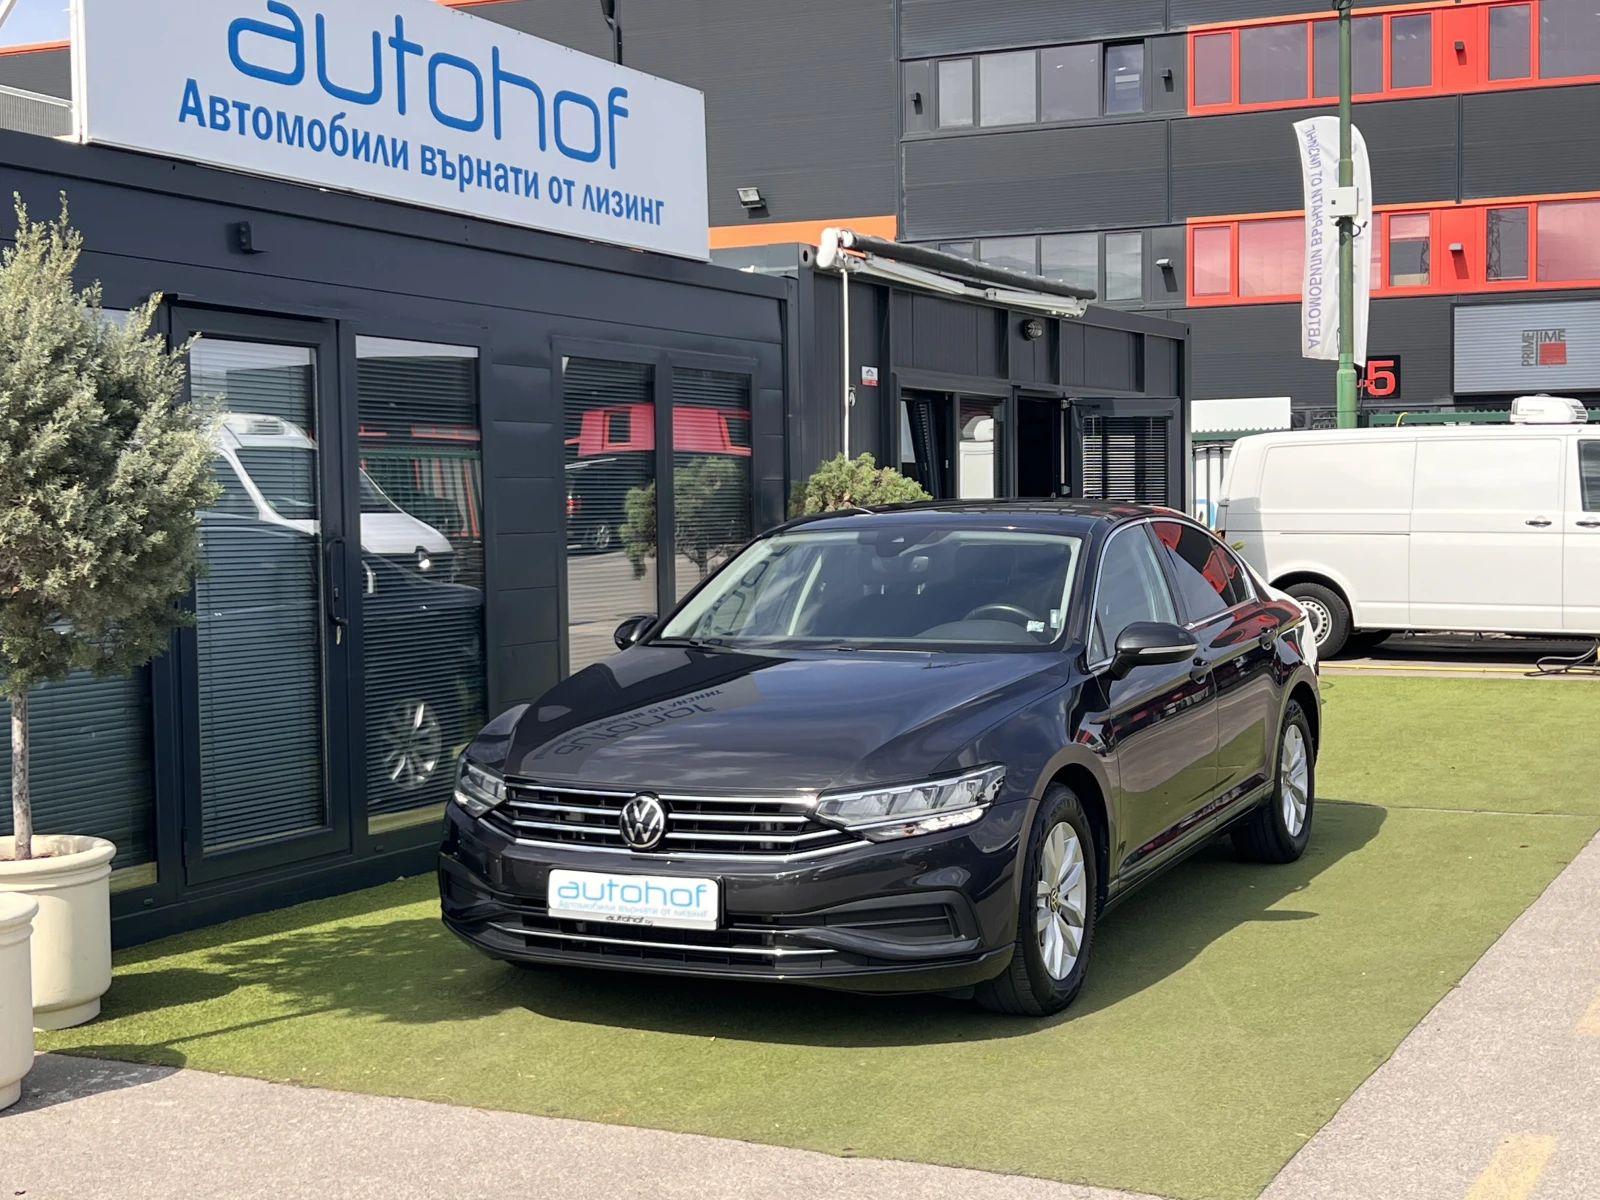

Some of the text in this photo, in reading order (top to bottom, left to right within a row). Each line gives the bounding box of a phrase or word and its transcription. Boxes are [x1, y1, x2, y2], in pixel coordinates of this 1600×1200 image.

[228, 0, 629, 169] autohof
[179, 78, 665, 226] Автомобили върнати от лизинг
[1522, 331, 1535, 366] PRIME
[1367, 360, 1396, 396] 5
[557, 878, 708, 908] autohof
